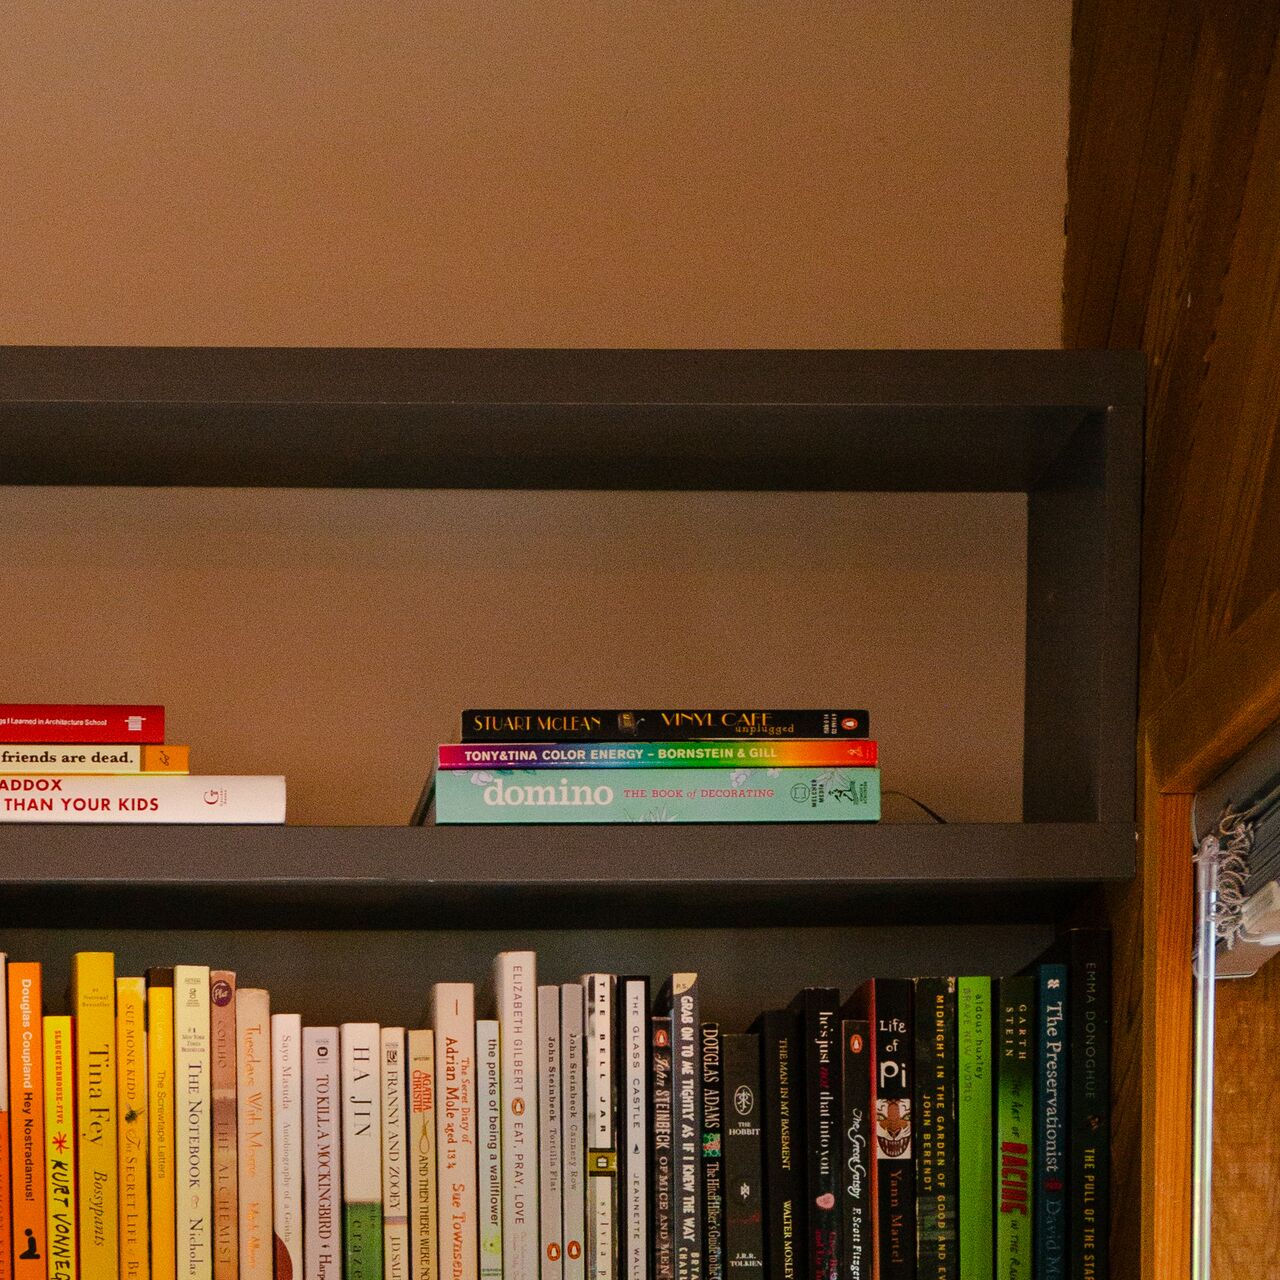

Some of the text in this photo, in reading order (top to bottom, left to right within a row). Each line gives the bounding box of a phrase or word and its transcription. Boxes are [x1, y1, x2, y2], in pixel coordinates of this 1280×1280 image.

[475, 716, 601, 731] STUART McLEAN
[662, 713, 773, 726] VINYL CAFE
[736, 724, 794, 735] unplugged
[2, 751, 56, 762] friends
[62, 754, 86, 762] are
[92, 752, 133, 763] dead.
[465, 749, 777, 761] TONY&TINA COLOR ENERGY BORNSTEIN & GILL
[5, 799, 53, 810] THAN
[61, 799, 110, 810] YOUR
[119, 799, 159, 810] KIDS
[484, 778, 613, 806] domino
[624, 790, 774, 799] THE BOOK of DECORATING
[681, 996, 693, 1024] GRAB
[19, 979, 33, 1088] Douglas Coupland
[513, 966, 524, 1091] ELIZABETH GILBERT
[682, 1027, 693, 1042] ON
[880, 1020, 907, 1033] Life
[1005, 1007, 1014, 1057] STEIN
[1018, 1004, 1027, 1060] GARTH
[445, 1037, 458, 1081] Adrian
[488, 1039, 498, 1057] the
[682, 1045, 693, 1057] TO
[886, 1039, 900, 1052] of
[54, 1030, 63, 1124] SLAUGHTERHOUSE-FIVE
[487, 1060, 498, 1097] perks
[681, 1061, 692, 1075] ME
[703, 1029, 719, 1128] DOUGLAS ADAMS
[880, 1061, 906, 1088] pi
[82, 1044, 110, 1146] Tina Fey
[316, 1075, 328, 1093] TO
[350, 1047, 371, 1136] HA JIN
[413, 1070, 423, 1113] CHRISTIE
[422, 1073, 432, 1110] AGATHA
[1045, 1002, 1062, 1171] The Preservationist
[317, 1096, 329, 1127] KILL
[446, 1087, 458, 1118] Mole
[489, 1101, 499, 1112] of
[682, 1079, 693, 1119] TIGHTLY
[188, 1061, 203, 1188] THE NOTEBOOK
[317, 1129, 328, 1140] A
[445, 1123, 456, 1144] aged
[487, 1115, 499, 1150] being
[513, 1123, 524, 1148] EAT,
[682, 1124, 693, 1138] AS
[22, 1092, 35, 1201] Hey Nostradamus!
[447, 1149, 455, 1159] 13
[682, 1143, 693, 1152] IF
[1084, 1149, 1095, 1170] THE
[51, 1159, 68, 1208] KURT
[513, 1153, 525, 1189] PRAY,
[682, 1165, 694, 1192] KNEW
[318, 1145, 331, 1239] MOCKINGBIRD
[452, 1184, 465, 1207] Sue
[490, 1165, 500, 1225] wallflower
[1084, 1176, 1095, 1203] PULL
[90, 1171, 108, 1247] Bossypants
[515, 1194, 525, 1224] LOVE
[683, 1196, 695, 1214] THE
[1084, 1209, 1095, 1220] OF
[683, 1217, 695, 1241] WAY
[1084, 1227, 1095, 1249] THE
